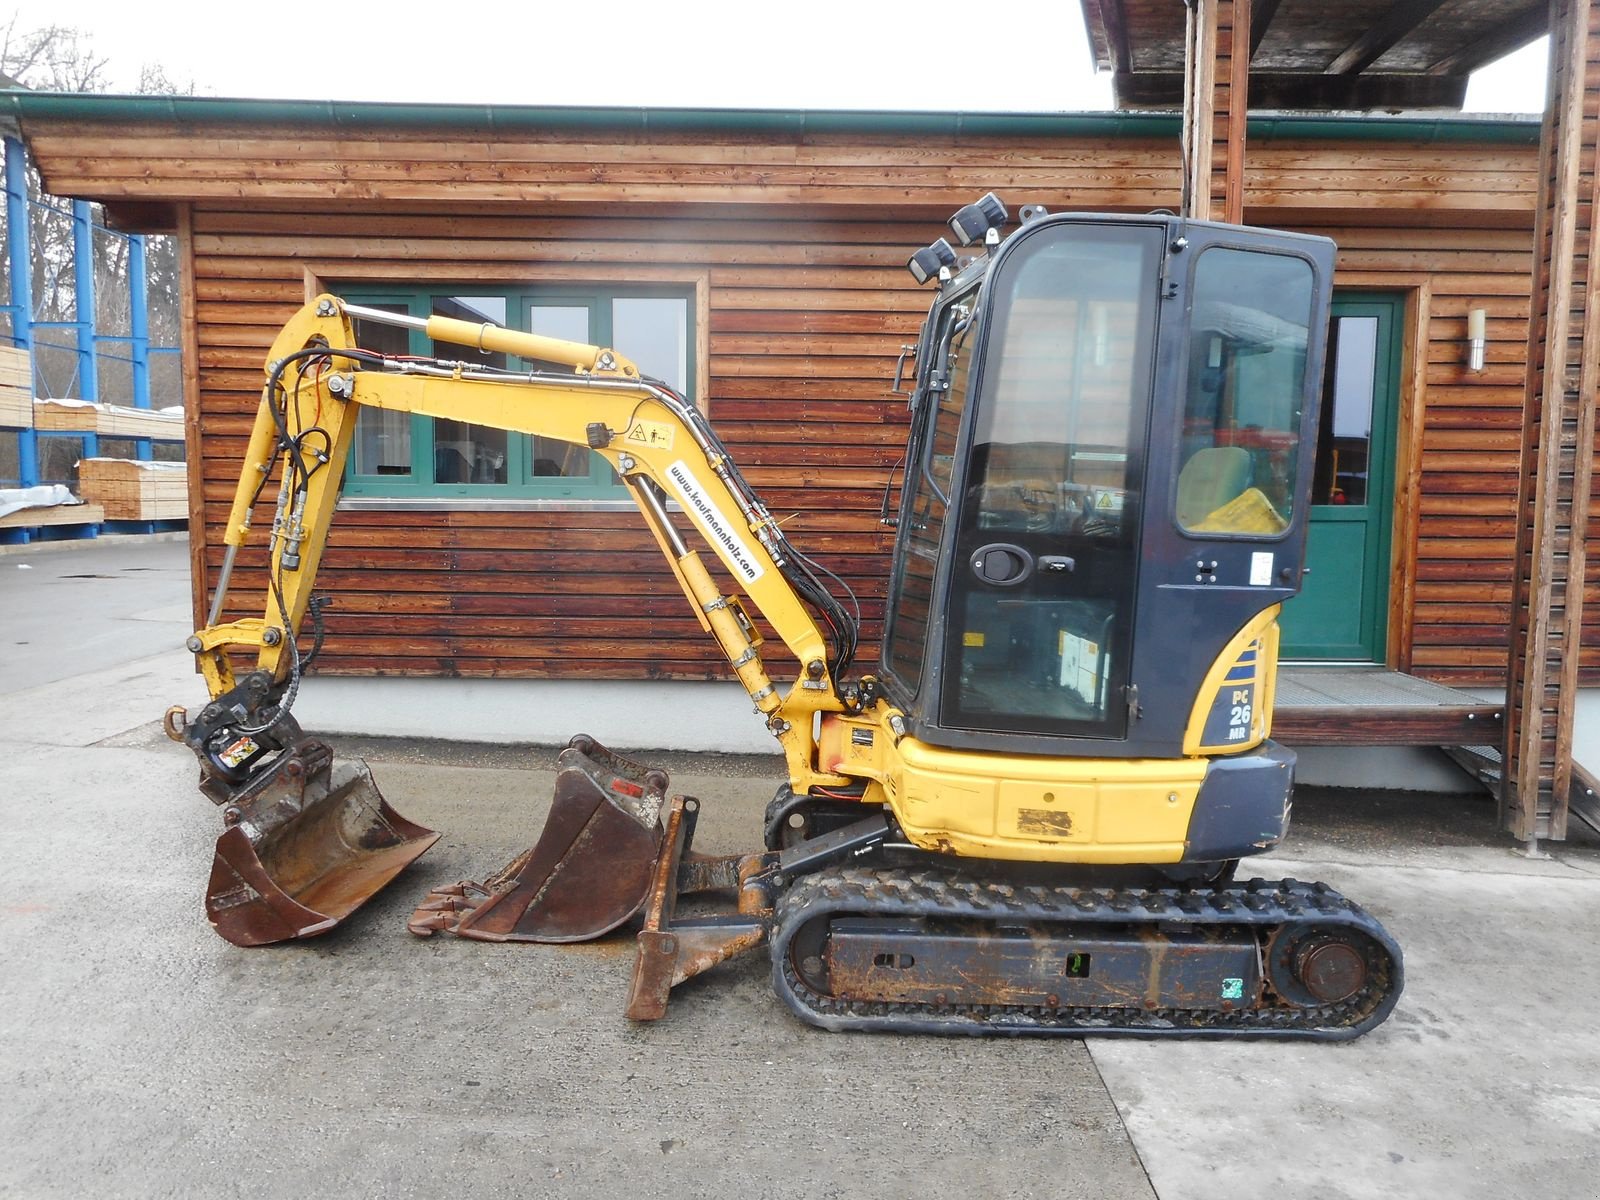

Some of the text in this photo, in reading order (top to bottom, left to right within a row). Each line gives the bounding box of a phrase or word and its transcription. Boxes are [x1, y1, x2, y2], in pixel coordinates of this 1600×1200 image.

[671, 466, 756, 579] www.kaufmannholz.com
[1232, 690, 1249, 705] PC
[1230, 705, 1251, 726] 26
[1229, 727, 1246, 740] MR
